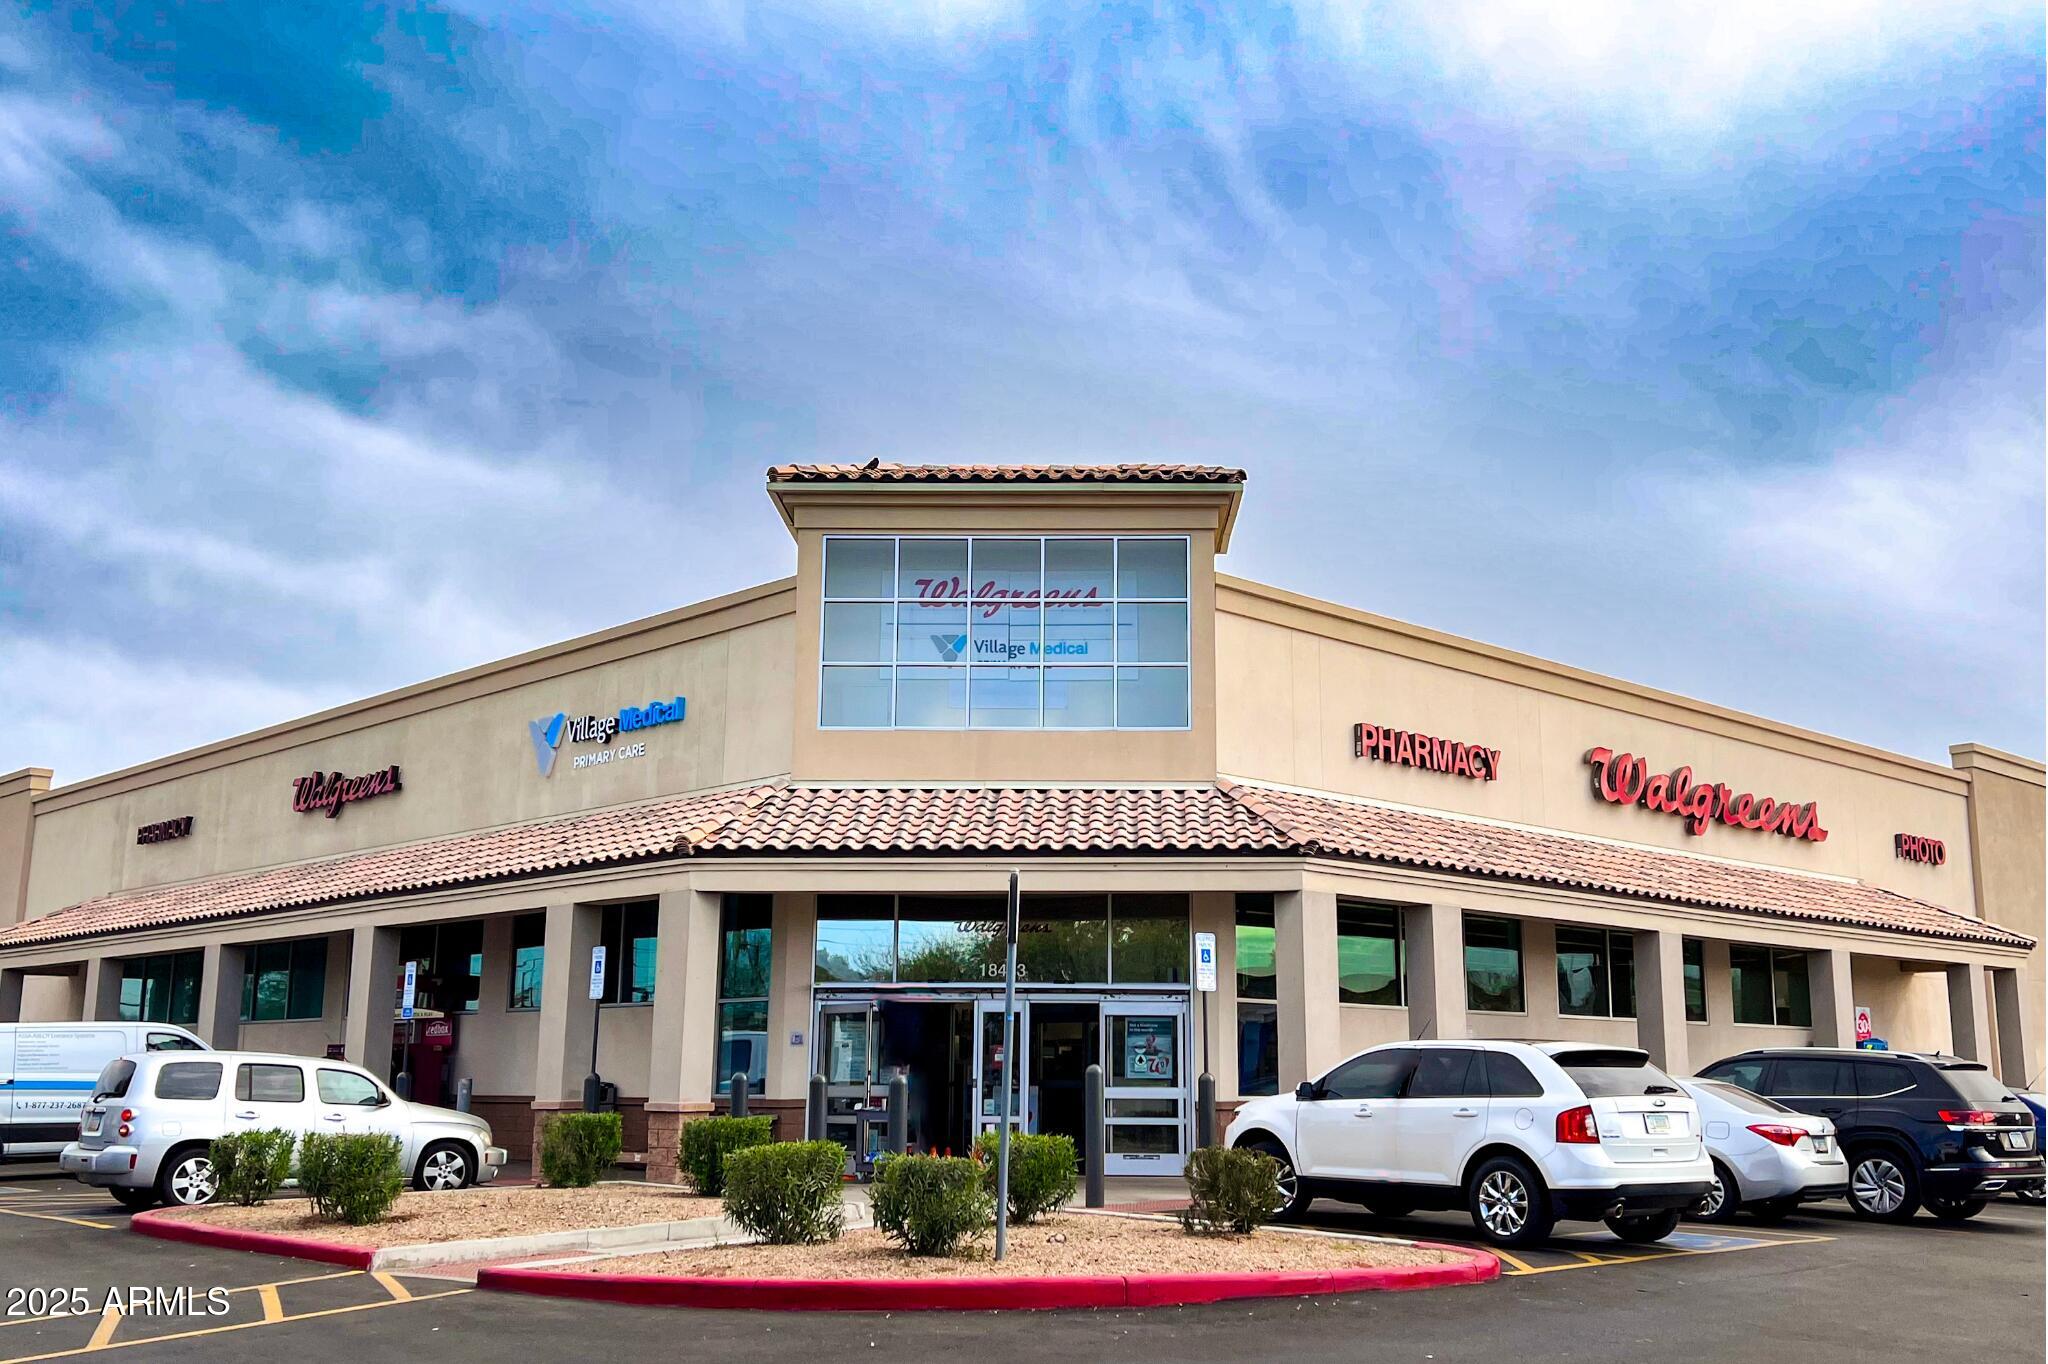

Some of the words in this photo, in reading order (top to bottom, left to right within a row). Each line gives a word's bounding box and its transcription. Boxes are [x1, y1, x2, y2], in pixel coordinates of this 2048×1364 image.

[914, 576, 1104, 618] Walgreens
[973, 639, 1026, 660] Village
[1029, 641, 1088, 656] Medical
[566, 715, 619, 744] Village
[619, 696, 686, 732] Medical
[573, 749, 616, 769] PRIMARY
[618, 742, 645, 760] CARE
[1354, 722, 1501, 781] PHARMACY
[292, 765, 402, 819] Walgreens
[1586, 746, 1829, 842] Walgreens
[137, 816, 194, 845] PHARMACY
[1895, 833, 1946, 865] PHOTO
[980, 963, 1026, 977] 1843
